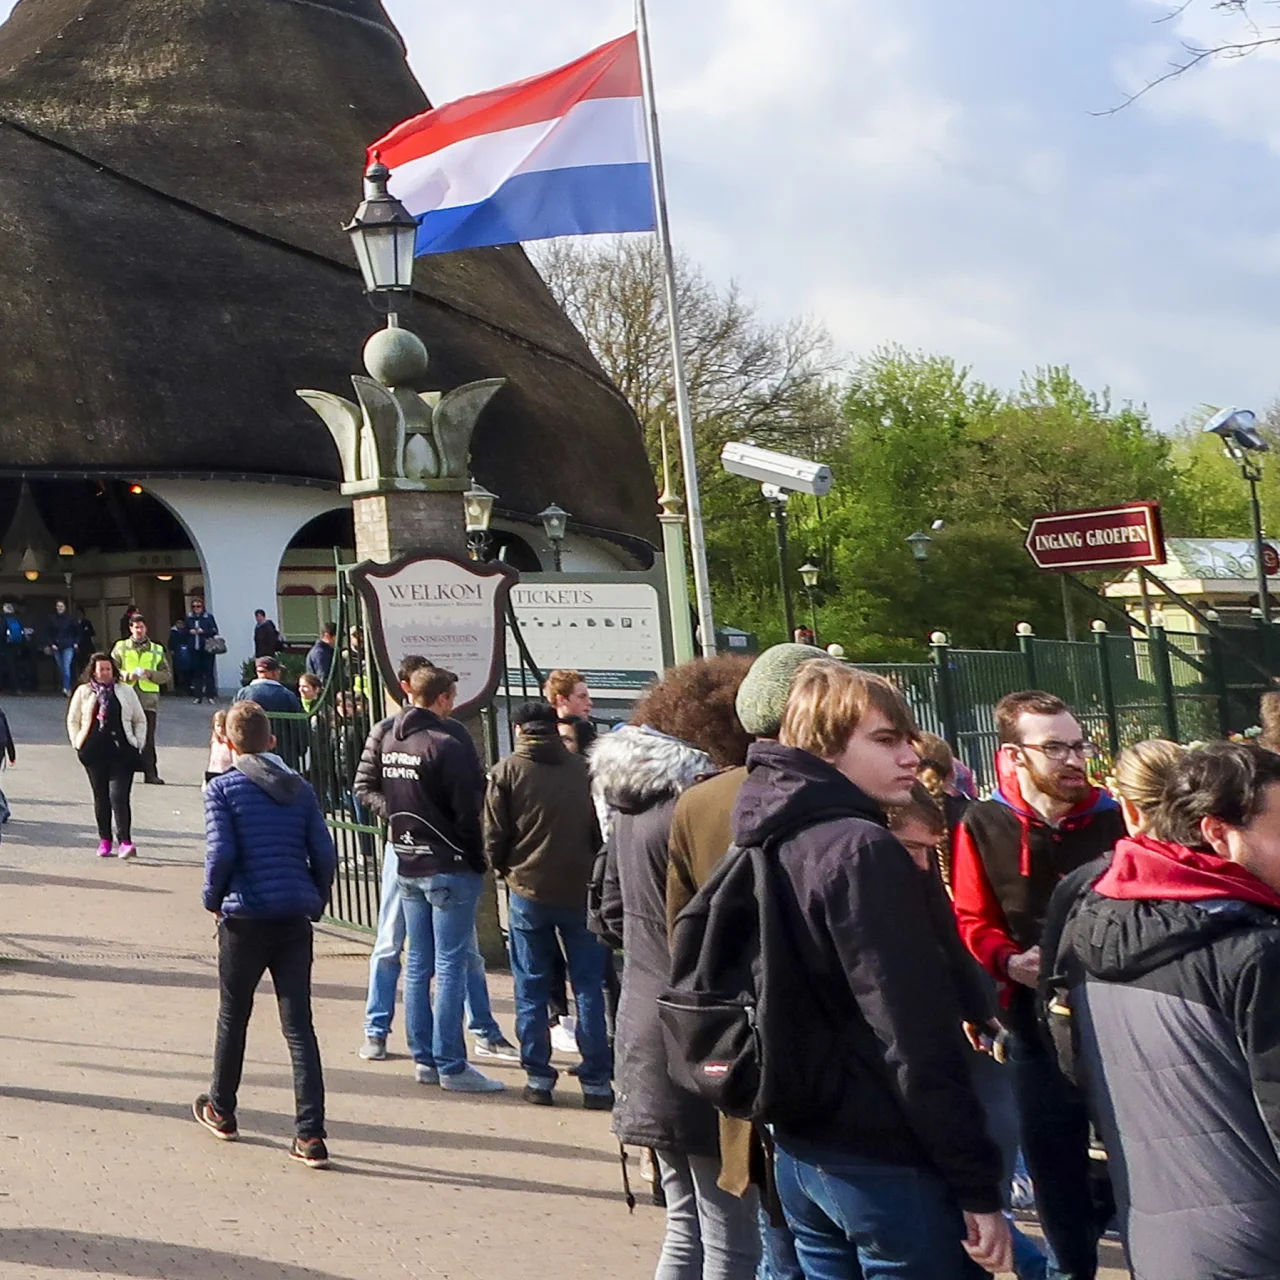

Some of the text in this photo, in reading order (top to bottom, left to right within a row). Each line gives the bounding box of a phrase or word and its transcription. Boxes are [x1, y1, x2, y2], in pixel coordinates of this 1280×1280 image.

[1035, 524, 1148, 551] INGANG GROEPEN
[388, 583, 484, 600] WELKOM
[513, 590, 594, 604] TICKETS
